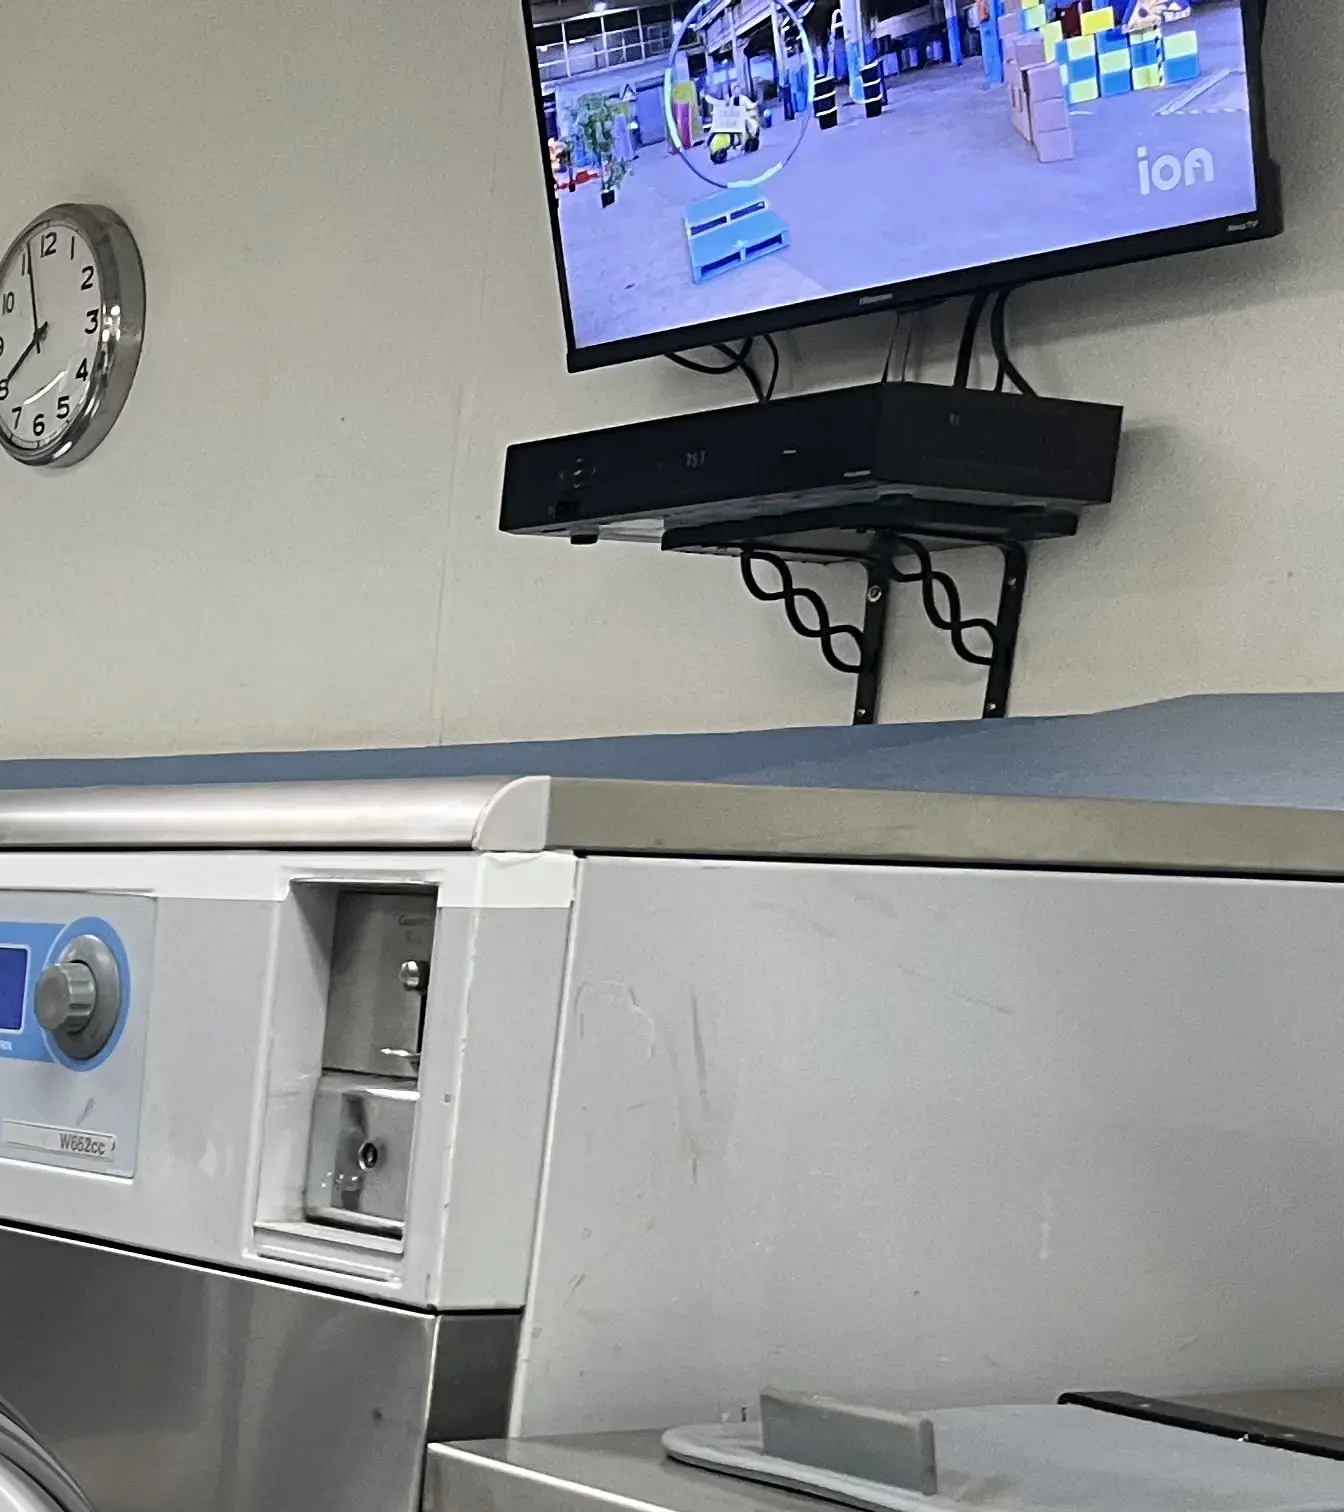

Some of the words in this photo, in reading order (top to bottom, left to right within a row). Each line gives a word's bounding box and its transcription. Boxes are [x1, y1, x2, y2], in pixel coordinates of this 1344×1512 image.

[39, 232, 58, 258] 12
[69, 235, 76, 261] 1
[80, 266, 95, 291] 2
[2, 292, 16, 316] 10
[84, 309, 100, 334] 3
[75, 357, 89, 382] 4
[11, 406, 23, 430] 7
[56, 396, 71, 420] 5
[32, 413, 46, 436] 6
